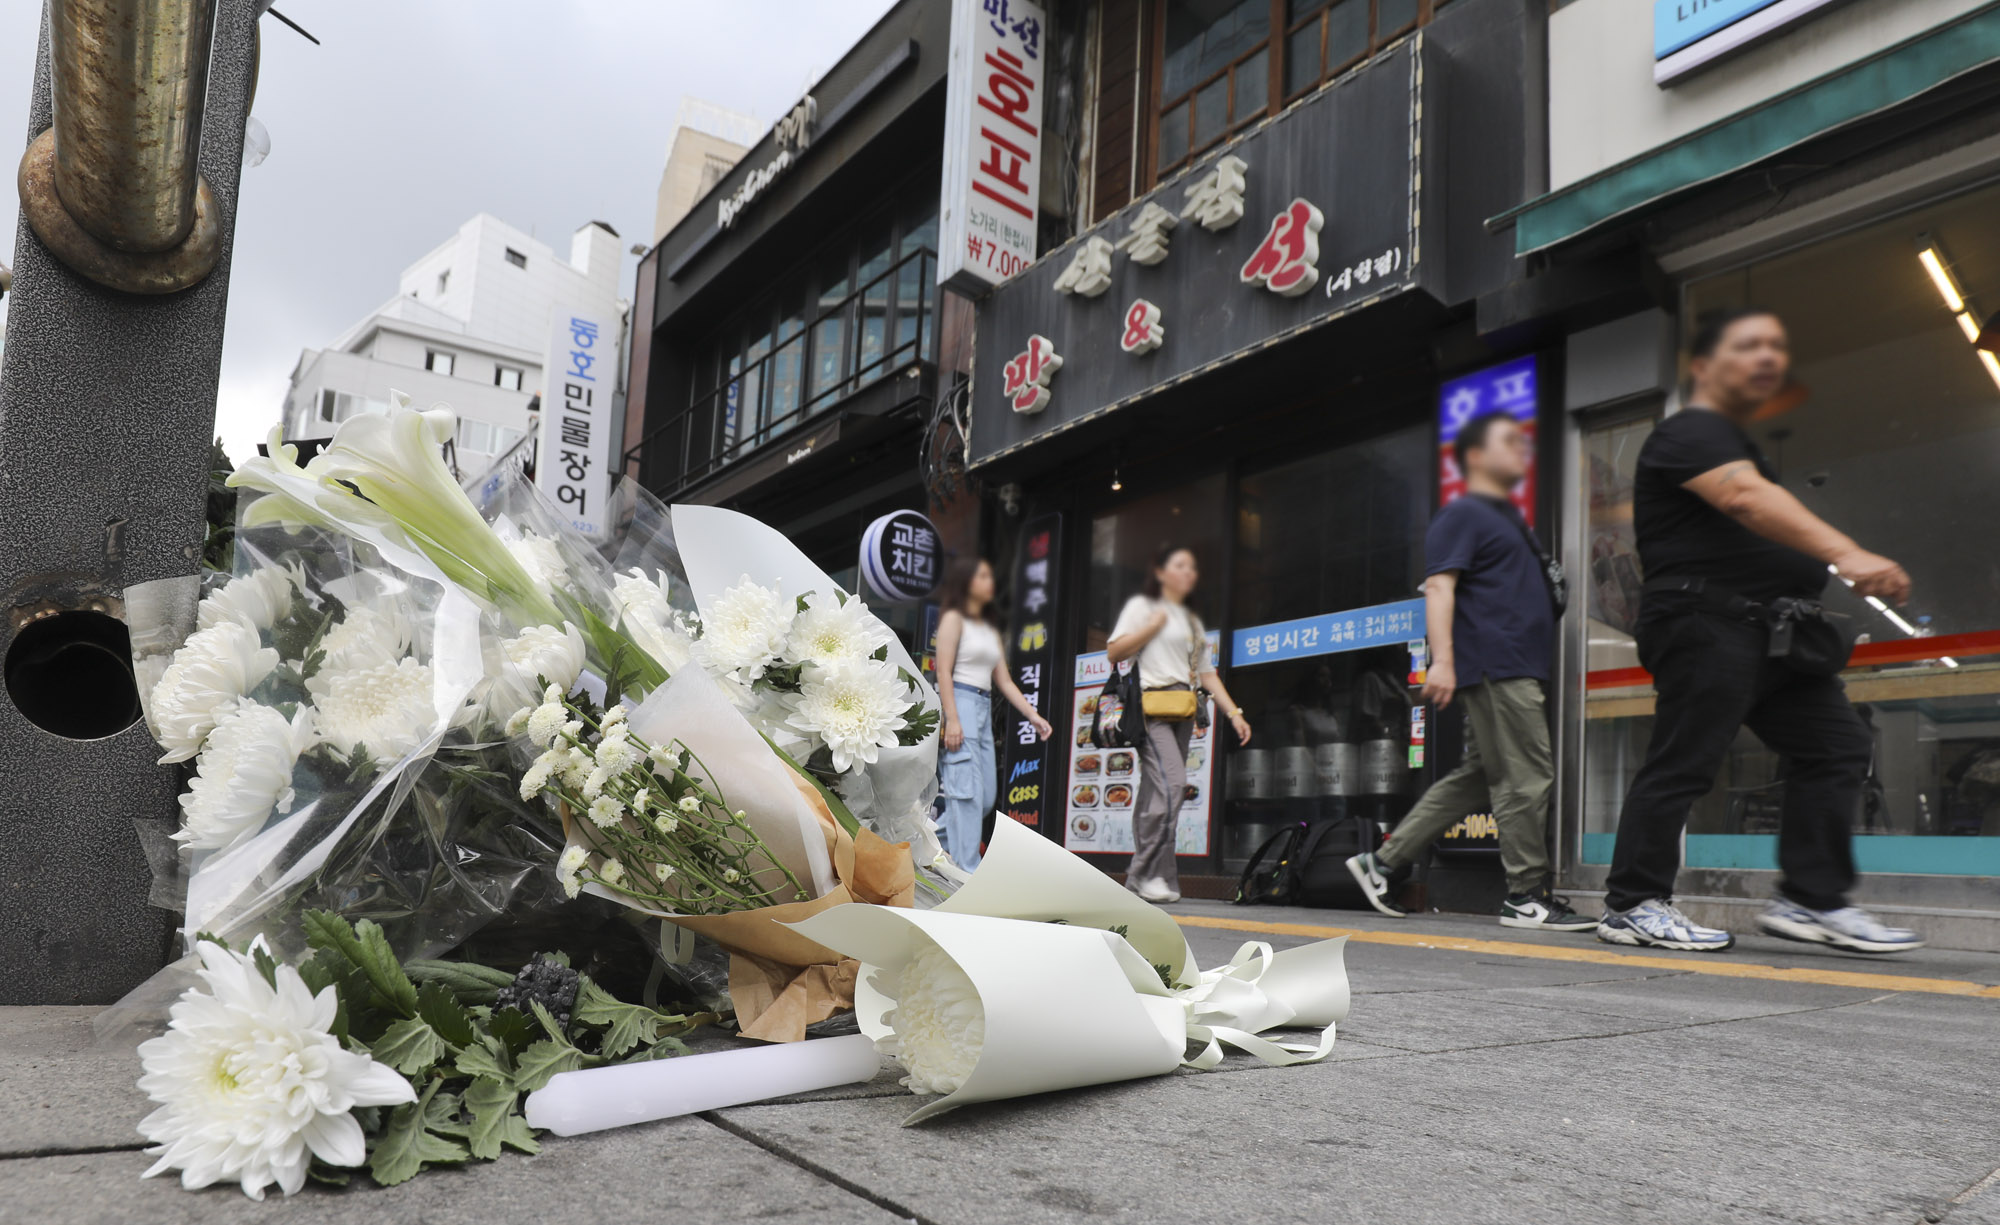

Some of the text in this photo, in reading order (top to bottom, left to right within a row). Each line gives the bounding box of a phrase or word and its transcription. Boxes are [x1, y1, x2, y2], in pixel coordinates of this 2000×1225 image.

[972, 46, 1038, 221] 호프
[969, 206, 998, 237] 노가리
[1003, 334, 1060, 413] 만
[1241, 198, 1323, 296] 선
[891, 521, 934, 553] 교촌
[891, 548, 934, 579] 치킨
[1245, 626, 1320, 656] 영업시간
[1009, 758, 1041, 784] Max
